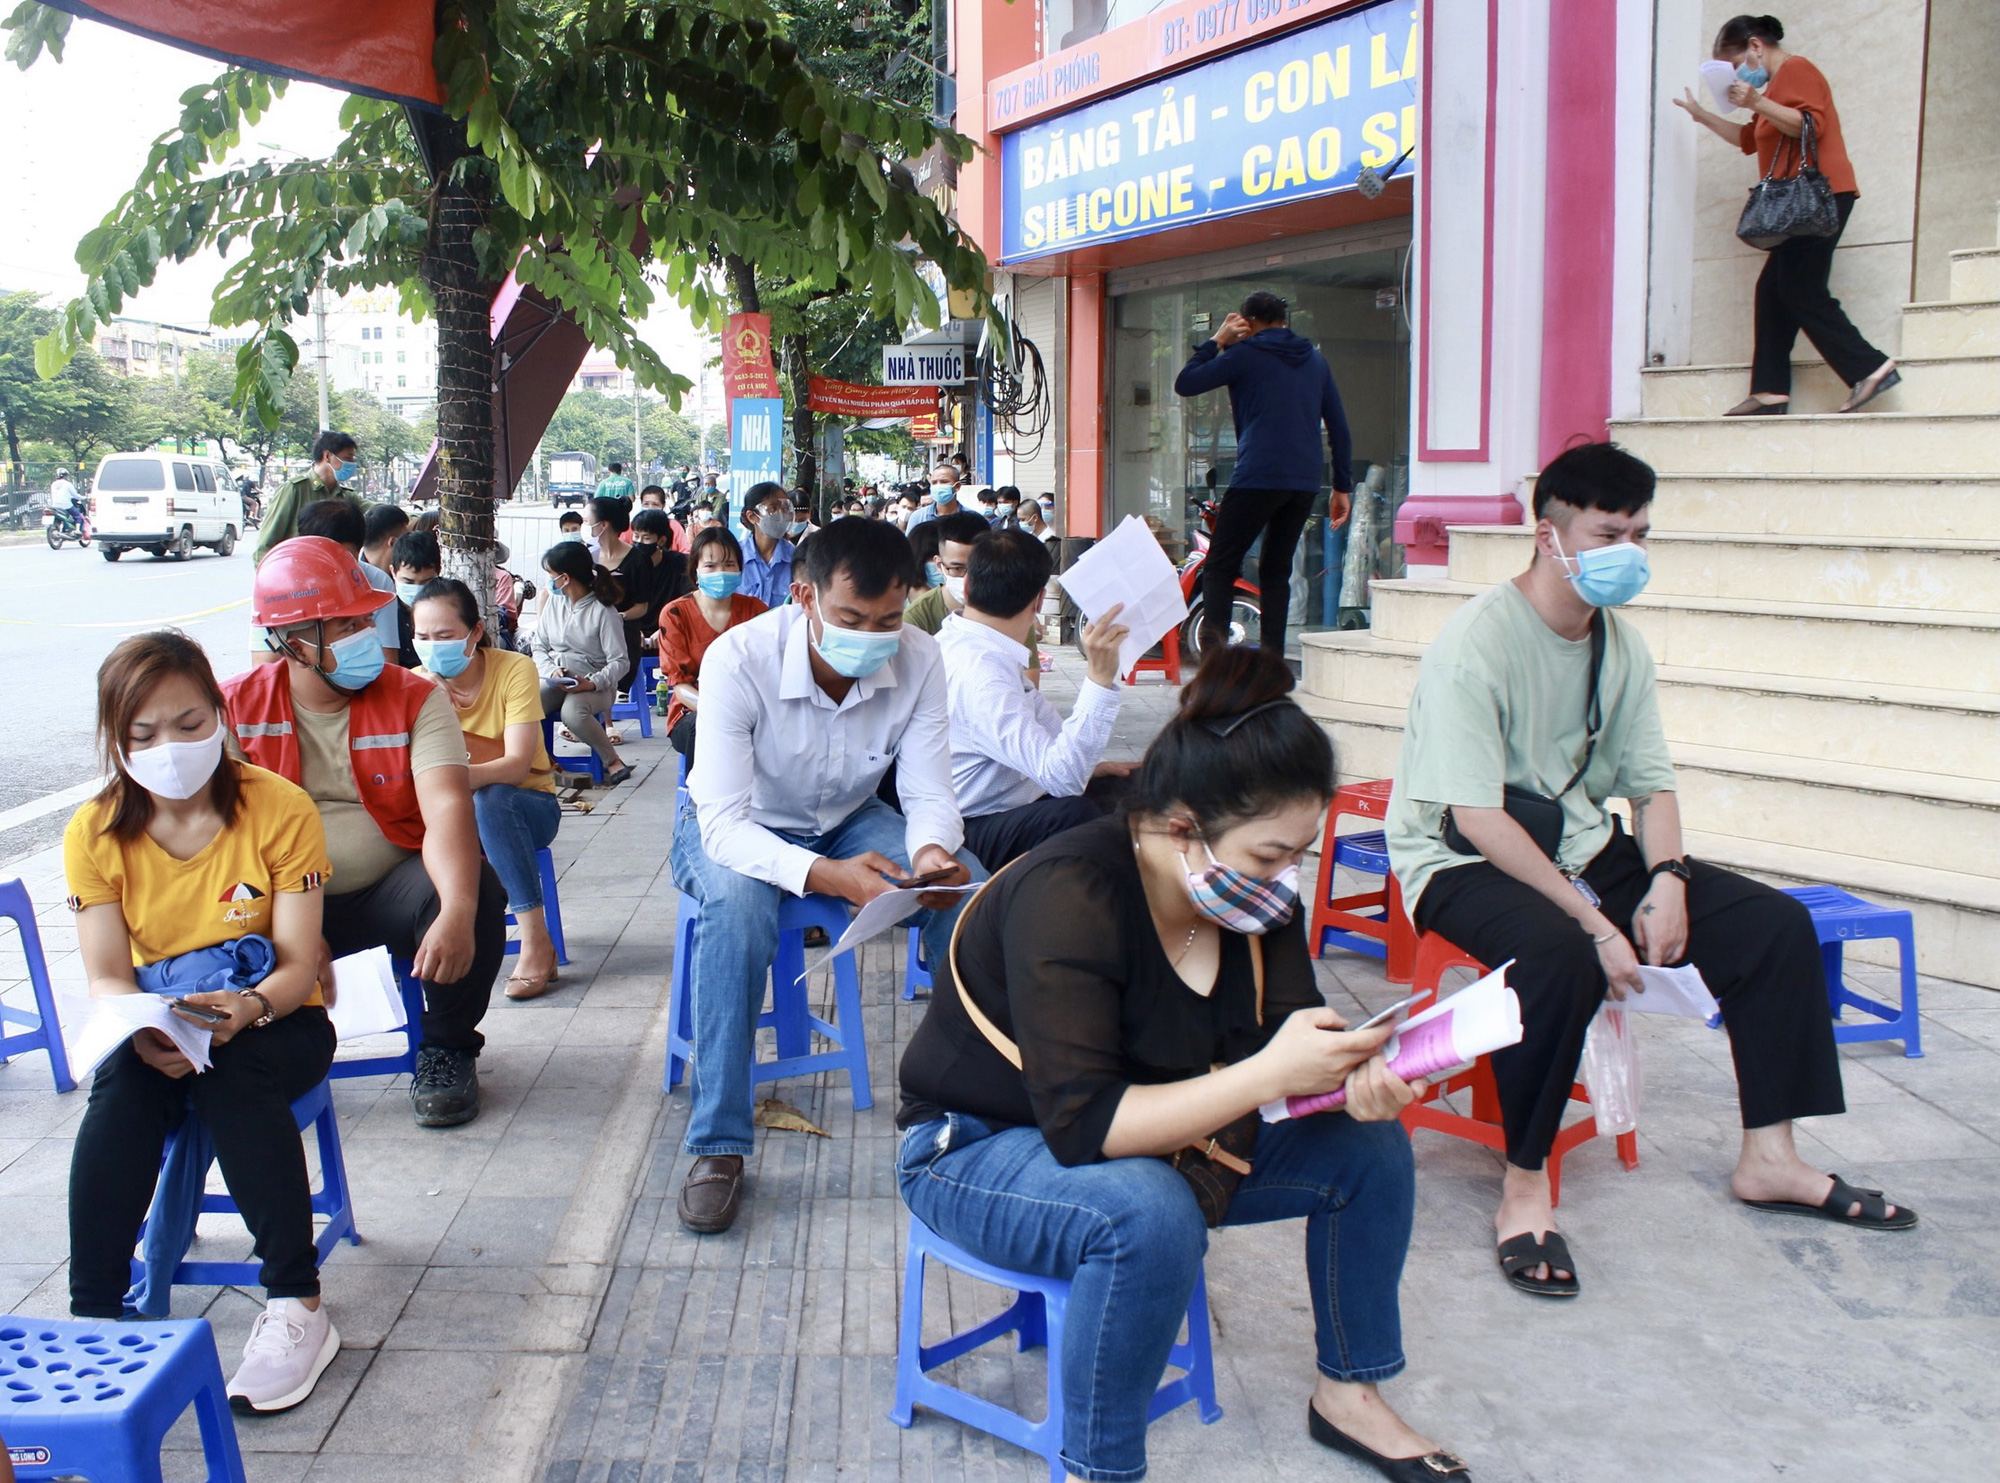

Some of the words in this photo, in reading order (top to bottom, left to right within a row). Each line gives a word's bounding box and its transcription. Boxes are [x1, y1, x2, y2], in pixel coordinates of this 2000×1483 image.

[995, 84, 1019, 119] 707
[1023, 61, 1049, 108] GIẢI
[1053, 52, 1100, 97] PHÓNG
[1163, 17, 1190, 56] ĐT:
[1195, 0, 1240, 43] 0977
[1024, 121, 1120, 190] BĂNG
[1132, 86, 1196, 157] TẢI
[1243, 45, 1350, 124] CON
[1023, 164, 1194, 248] SILICONE
[1241, 126, 1341, 197] CAO
[888, 352, 915, 380] NHÀ
[919, 348, 961, 380] THUỐC
[741, 406, 771, 452] NHÀ
[290, 588, 320, 599] Vietnam
